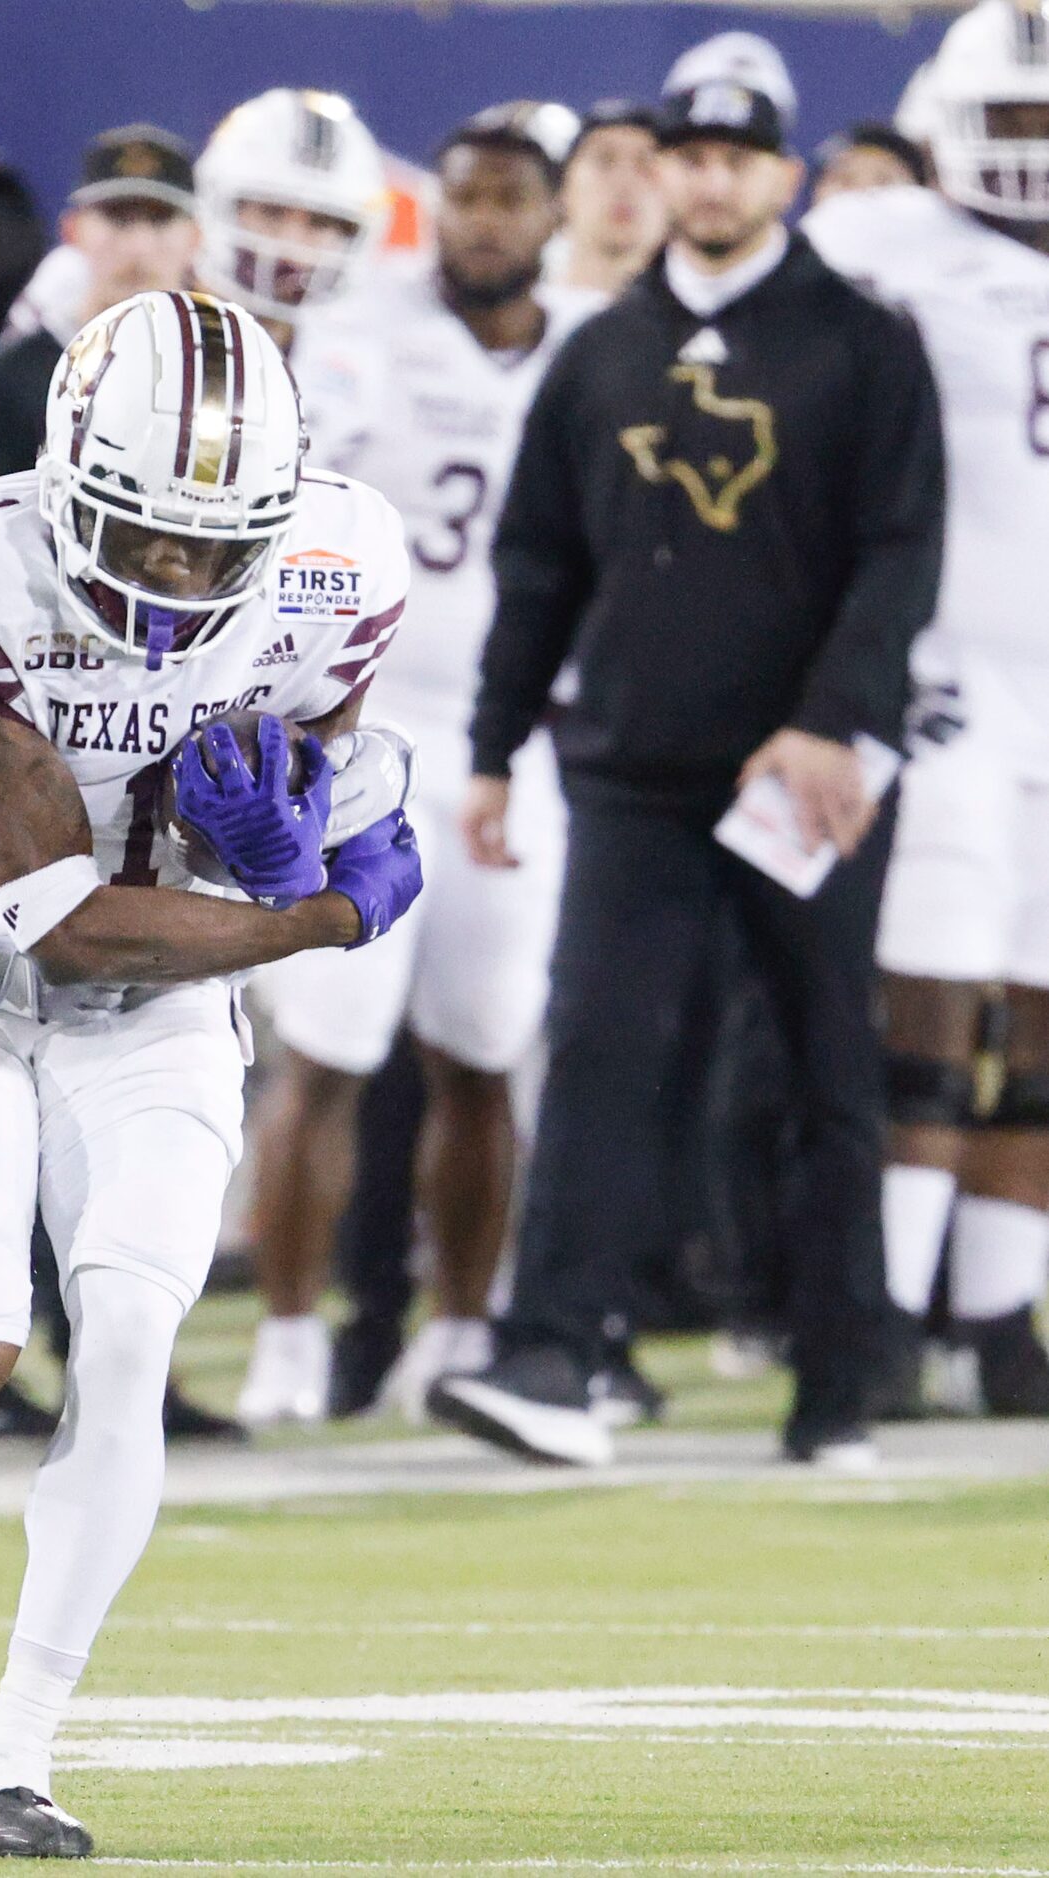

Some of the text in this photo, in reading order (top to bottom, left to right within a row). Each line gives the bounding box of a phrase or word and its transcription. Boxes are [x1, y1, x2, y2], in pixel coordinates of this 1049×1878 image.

[412, 462, 488, 573] 3
[278, 568, 362, 593] F1RST
[278, 592, 361, 606] RESPONDER
[303, 605, 332, 616] BOWL
[24, 634, 104, 672] SBC
[252, 653, 299, 668] adidas
[48, 697, 169, 755] TEXAS
